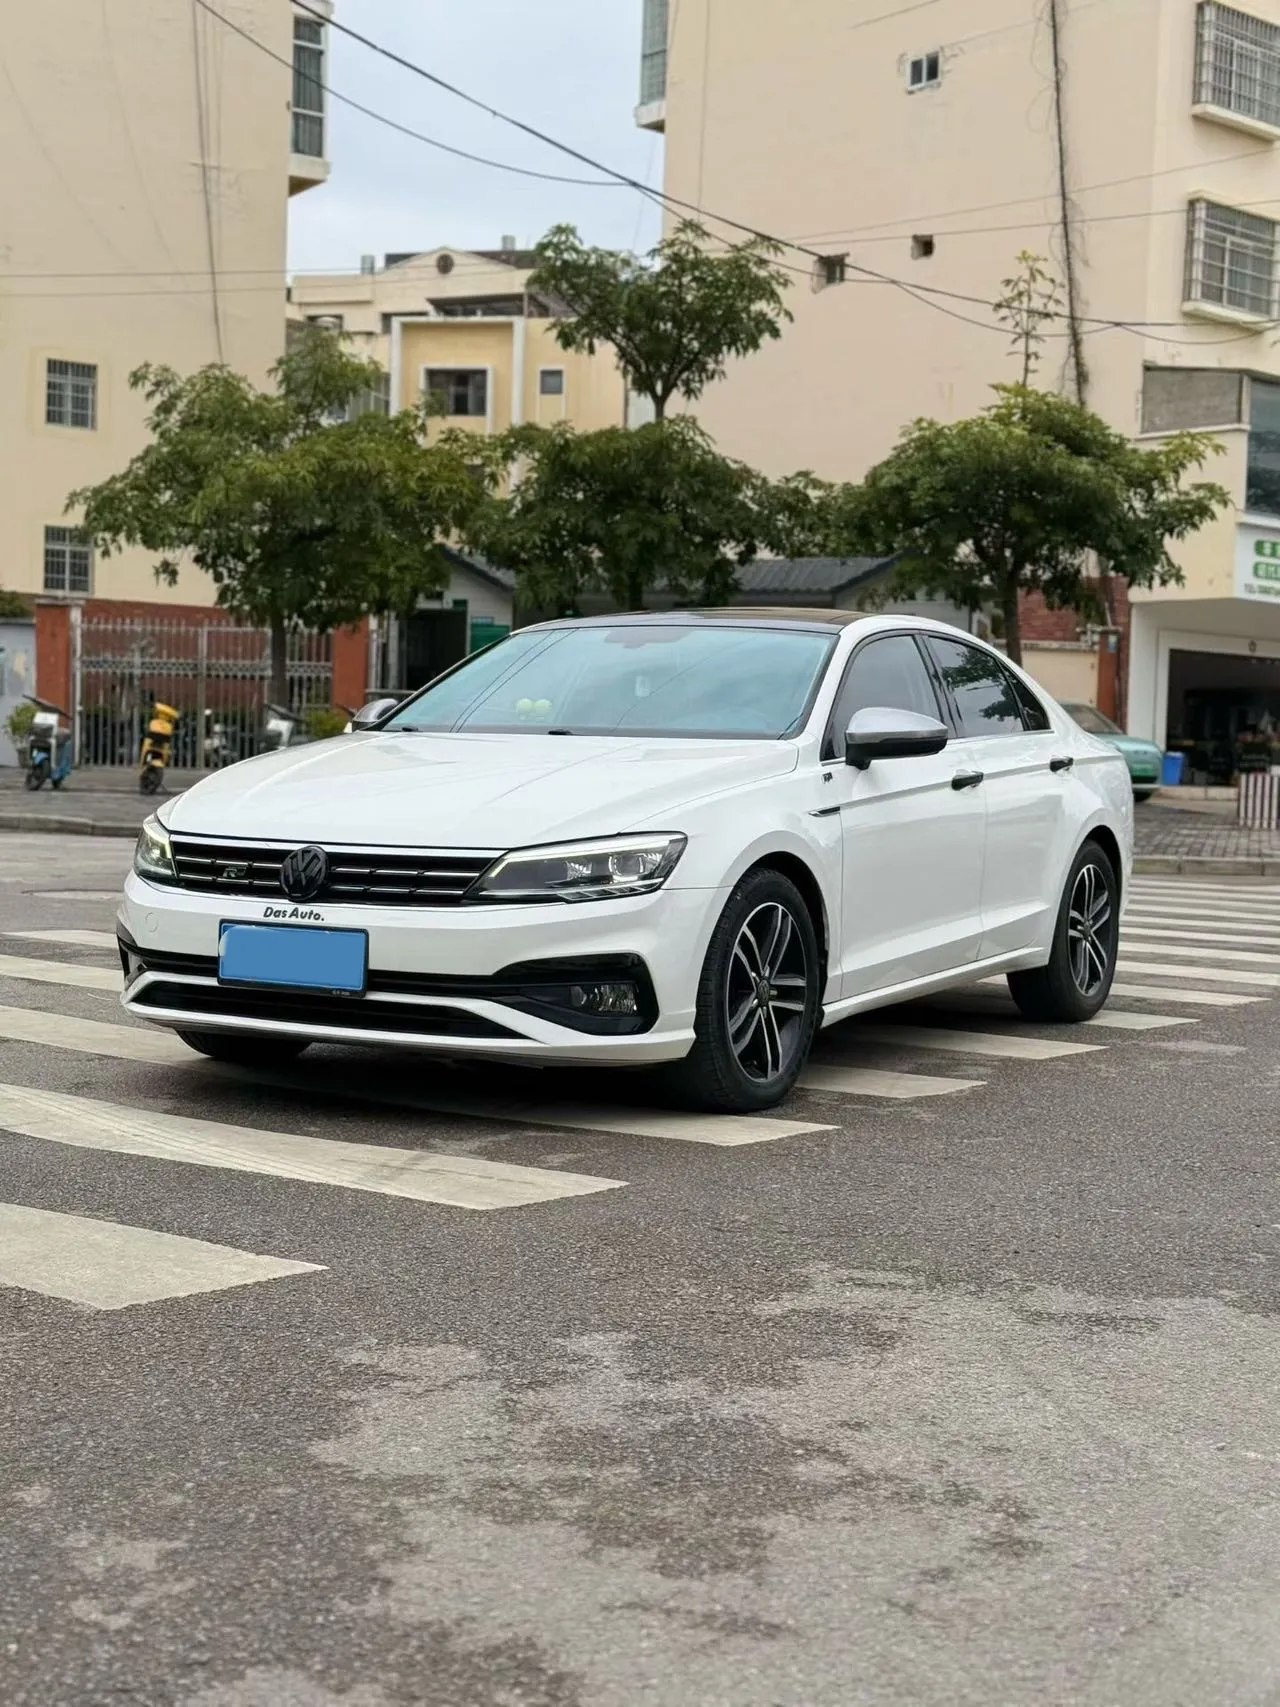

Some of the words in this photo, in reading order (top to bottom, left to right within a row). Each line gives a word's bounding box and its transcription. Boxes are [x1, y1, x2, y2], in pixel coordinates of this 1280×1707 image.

[281, 846, 327, 900] VW
[263, 906, 288, 918] Das
[288, 906, 325, 921] Auto.
